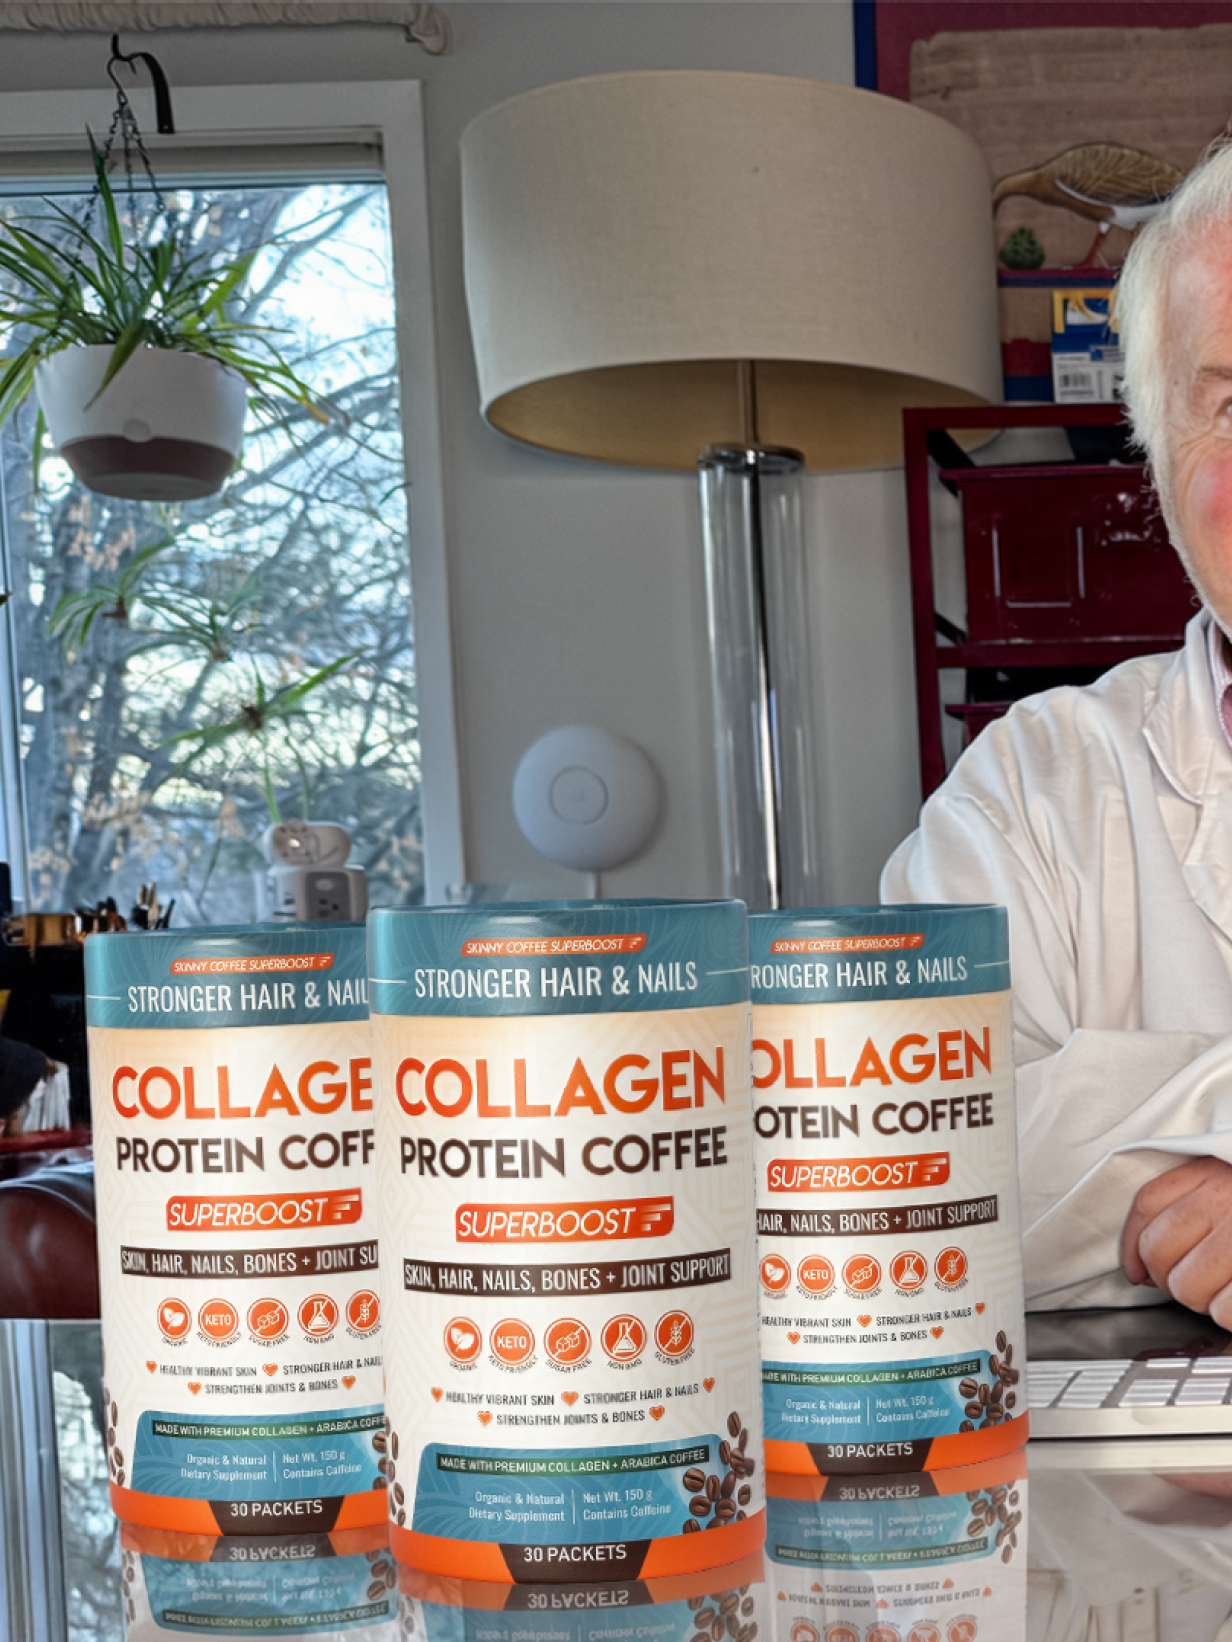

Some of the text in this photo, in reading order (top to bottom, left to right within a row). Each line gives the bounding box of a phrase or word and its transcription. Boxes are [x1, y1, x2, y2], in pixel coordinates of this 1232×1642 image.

[466, 938, 624, 954] SKINNY COFFEE SUPERBOOST
[775, 937, 906, 952] SKINNY COFFEE SUPERBOOST
[174, 957, 315, 973] SKINNY COFFEE SUPERBOOST
[751, 956, 968, 989] RONGER HAIR & NAILS
[415, 961, 698, 998] STRONGER HAIR & NAILS
[128, 977, 369, 1013] STRONGER HAIR & NAIL
[751, 1026, 992, 1089] OLLAGEN
[112, 1057, 373, 1120] COLLAGE
[395, 1047, 726, 1118] COLLAGEN
[755, 1092, 994, 1139] OTEIN COFFEE
[116, 1128, 375, 1173] PROTEIN COFF
[401, 1126, 728, 1178] PROTEIN COFFEE
[770, 1161, 918, 1189] SUPERBOOST
[169, 1197, 329, 1226] SUPERBOOST
[790, 1214, 835, 1234] NAILS,
[839, 1212, 889, 1232] BONES
[893, 1215, 902, 1224] +
[905, 1207, 943, 1229] JOINT
[947, 1199, 996, 1224] SUPPORT
[458, 1207, 636, 1238] SUPERBOOST
[151, 1253, 188, 1276] HAIR,
[191, 1254, 239, 1276] NAILS,
[243, 1252, 297, 1274] BONES
[301, 1256, 311, 1265] +
[314, 1247, 356, 1271] JOINT
[405, 1254, 729, 1292] SKIN, HAIR, NAILS, BONES + JOINT SUPPORT
[802, 1269, 829, 1280] KETO
[205, 1314, 232, 1326] KETO
[831, 1317, 851, 1327] SKIN
[922, 1312, 942, 1322] HAIR
[496, 1336, 527, 1348] KETO
[890, 1332, 897, 1342] &
[900, 1330, 928, 1341] BONES
[235, 1366, 257, 1377] SKIN
[283, 1362, 331, 1375] STRONGER
[333, 1359, 353, 1371] HAIR
[363, 1355, 384, 1367] NAIL
[780, 1372, 800, 1382] WITH
[802, 1374, 845, 1383] PREMIUM
[847, 1372, 899, 1383] COLLAGEN
[205, 1384, 262, 1395] STRENGTHEN
[298, 1382, 305, 1392] &
[308, 1379, 338, 1391] BONES
[446, 1383, 699, 1406] HEALTHY VIBRANT SKIN STRONGER HAIR & NAILS
[819, 1400, 827, 1410] &
[911, 1395, 926, 1406] 150
[497, 1409, 646, 1426] STRENGTHEN JOINTS & BONES
[155, 1422, 179, 1434] MADE
[179, 1425, 202, 1436] WITH
[203, 1426, 249, 1437] PREMIUM
[251, 1425, 307, 1436] COLLAGEN
[316, 1420, 358, 1433] ARABICA
[320, 1450, 337, 1461] 150
[827, 1442, 913, 1457] 30 PACKETS
[187, 1453, 267, 1466] Organic & Natural
[440, 1456, 466, 1470] MADE
[468, 1460, 493, 1471] WITH
[494, 1461, 547, 1473] PREMIUM
[548, 1460, 610, 1473] COLLAGEN
[620, 1455, 668, 1469] ARABICA
[668, 1448, 705, 1464] COFFEE
[181, 1468, 267, 1482] Dietary Supplement
[283, 1468, 323, 1479] Contains
[475, 1491, 565, 1505] Organic & Natural
[583, 1492, 601, 1504] Net
[624, 1488, 644, 1501] 150
[230, 1499, 323, 1517] 30 PACKETS
[469, 1507, 565, 1523] Dietary Supplement
[583, 1504, 672, 1520] Contains Caffeine
[523, 1544, 627, 1563] 30 PACKETS
